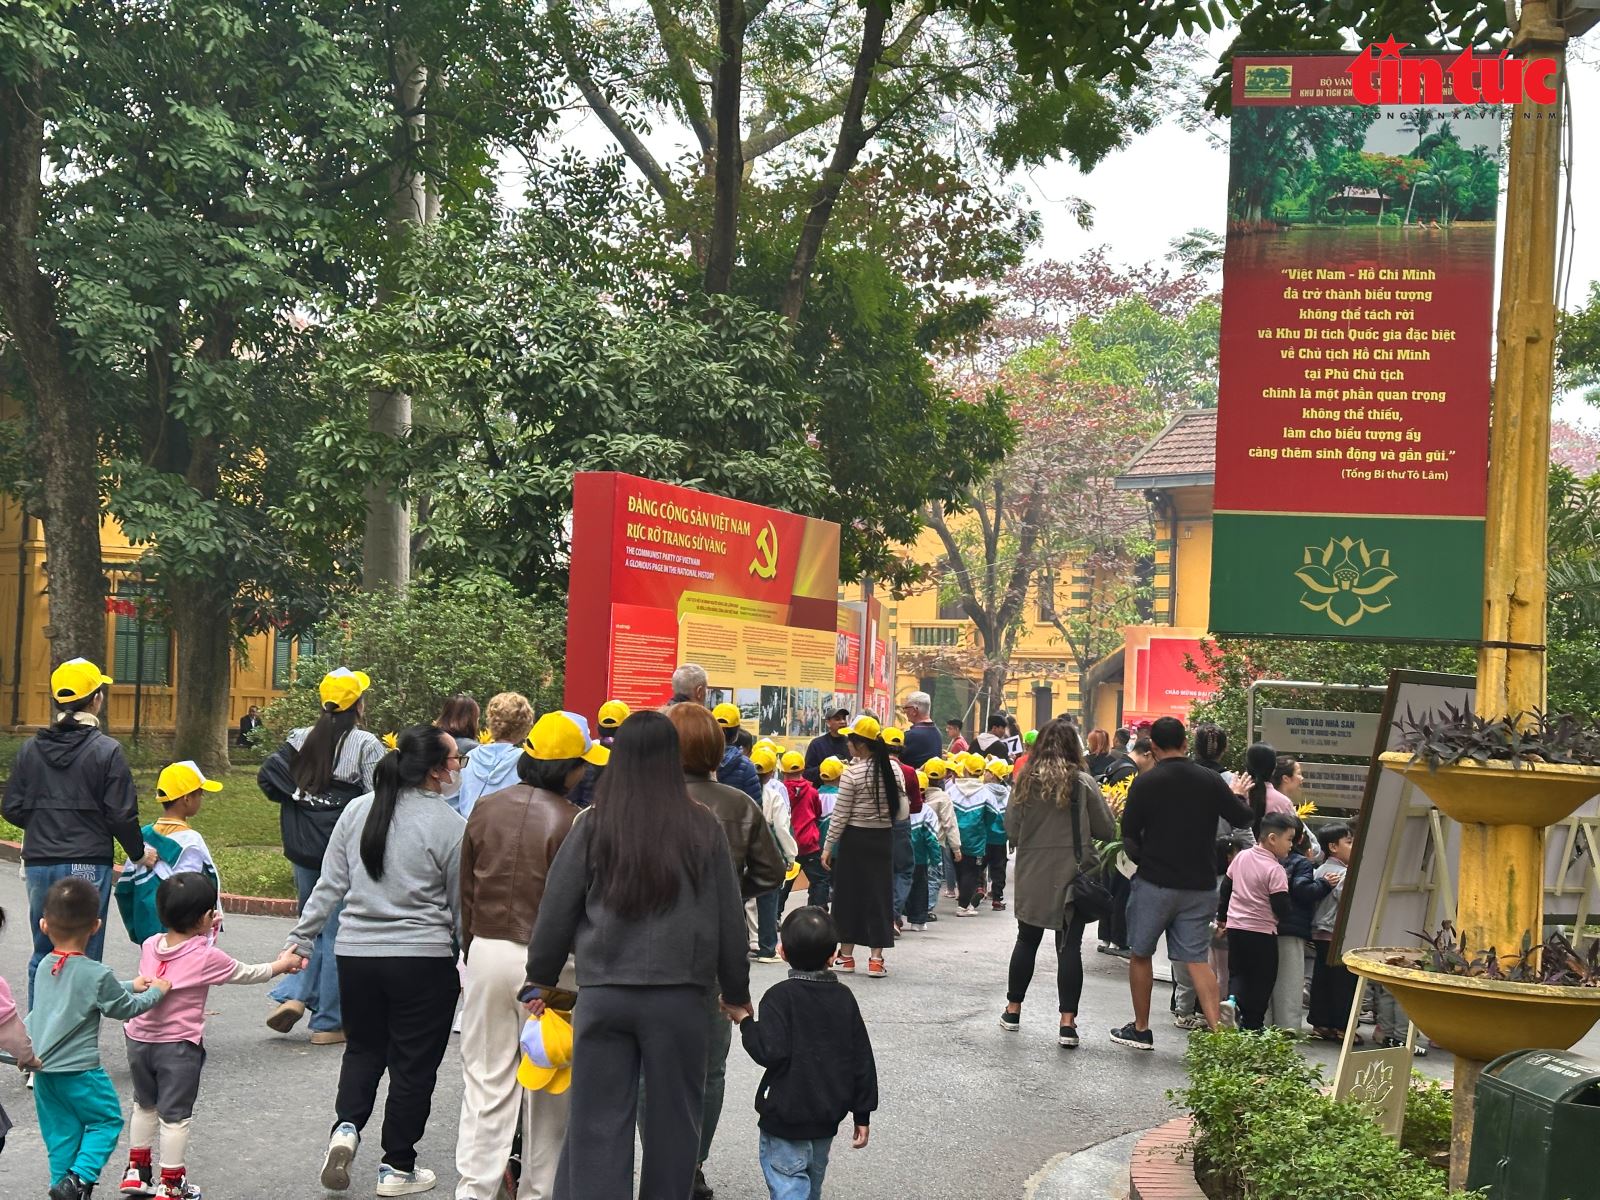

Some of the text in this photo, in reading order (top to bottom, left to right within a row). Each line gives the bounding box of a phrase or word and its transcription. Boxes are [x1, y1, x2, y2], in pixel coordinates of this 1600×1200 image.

[1320, 77, 1332, 87] BỘ
[1334, 77, 1352, 86] VĂN
[1300, 89, 1314, 97] KHU
[1316, 89, 1323, 97] DI
[1326, 88, 1341, 97] TÍCH
[1316, 269, 1345, 280] Nam
[1358, 267, 1375, 280] Hồ
[1379, 269, 1399, 280] Chí
[1402, 269, 1436, 280] Minh
[1284, 287, 1433, 302] đã trở thành biểu tượng
[1299, 307, 1415, 321] không thể tách rời
[1257, 327, 1456, 342] và Khu Di tích Quốc gia đặc biệt
[1281, 346, 1430, 361] về Chủ tịch Hồ Chí Minh
[1304, 368, 1404, 382] tại Phủ Chủ tịch
[1262, 387, 1446, 403] chính là một phần quan trọng
[1302, 406, 1403, 422] không thể thiếu,
[1283, 426, 1421, 442] làm cho biểu tượng ấy
[1248, 447, 1278, 459] càng
[1282, 447, 1312, 458] thêm
[1316, 448, 1343, 459] sinh
[1347, 447, 1376, 461] động
[1380, 449, 1395, 460] và
[1399, 447, 1422, 462] gần
[1341, 467, 1449, 481] (Tổng Bí thư Tô Lâm)
[628, 492, 751, 536] ĐẢNG CỘNG SẢN VIỆT NAM
[627, 522, 646, 542] RỰC
[648, 526, 662, 542] RỠ
[662, 530, 690, 548] TRANG
[704, 537, 727, 554] VÀNG
[626, 546, 635, 555] THE
[636, 548, 662, 559] COMMUNIST
[662, 553, 676, 562] PARTY
[682, 556, 701, 566] VIETNAM
[630, 559, 652, 570] GLORIOUS
[652, 563, 663, 572] PAGE
[677, 567, 698, 577] NATIONAL
[698, 570, 715, 579] HISTORY
